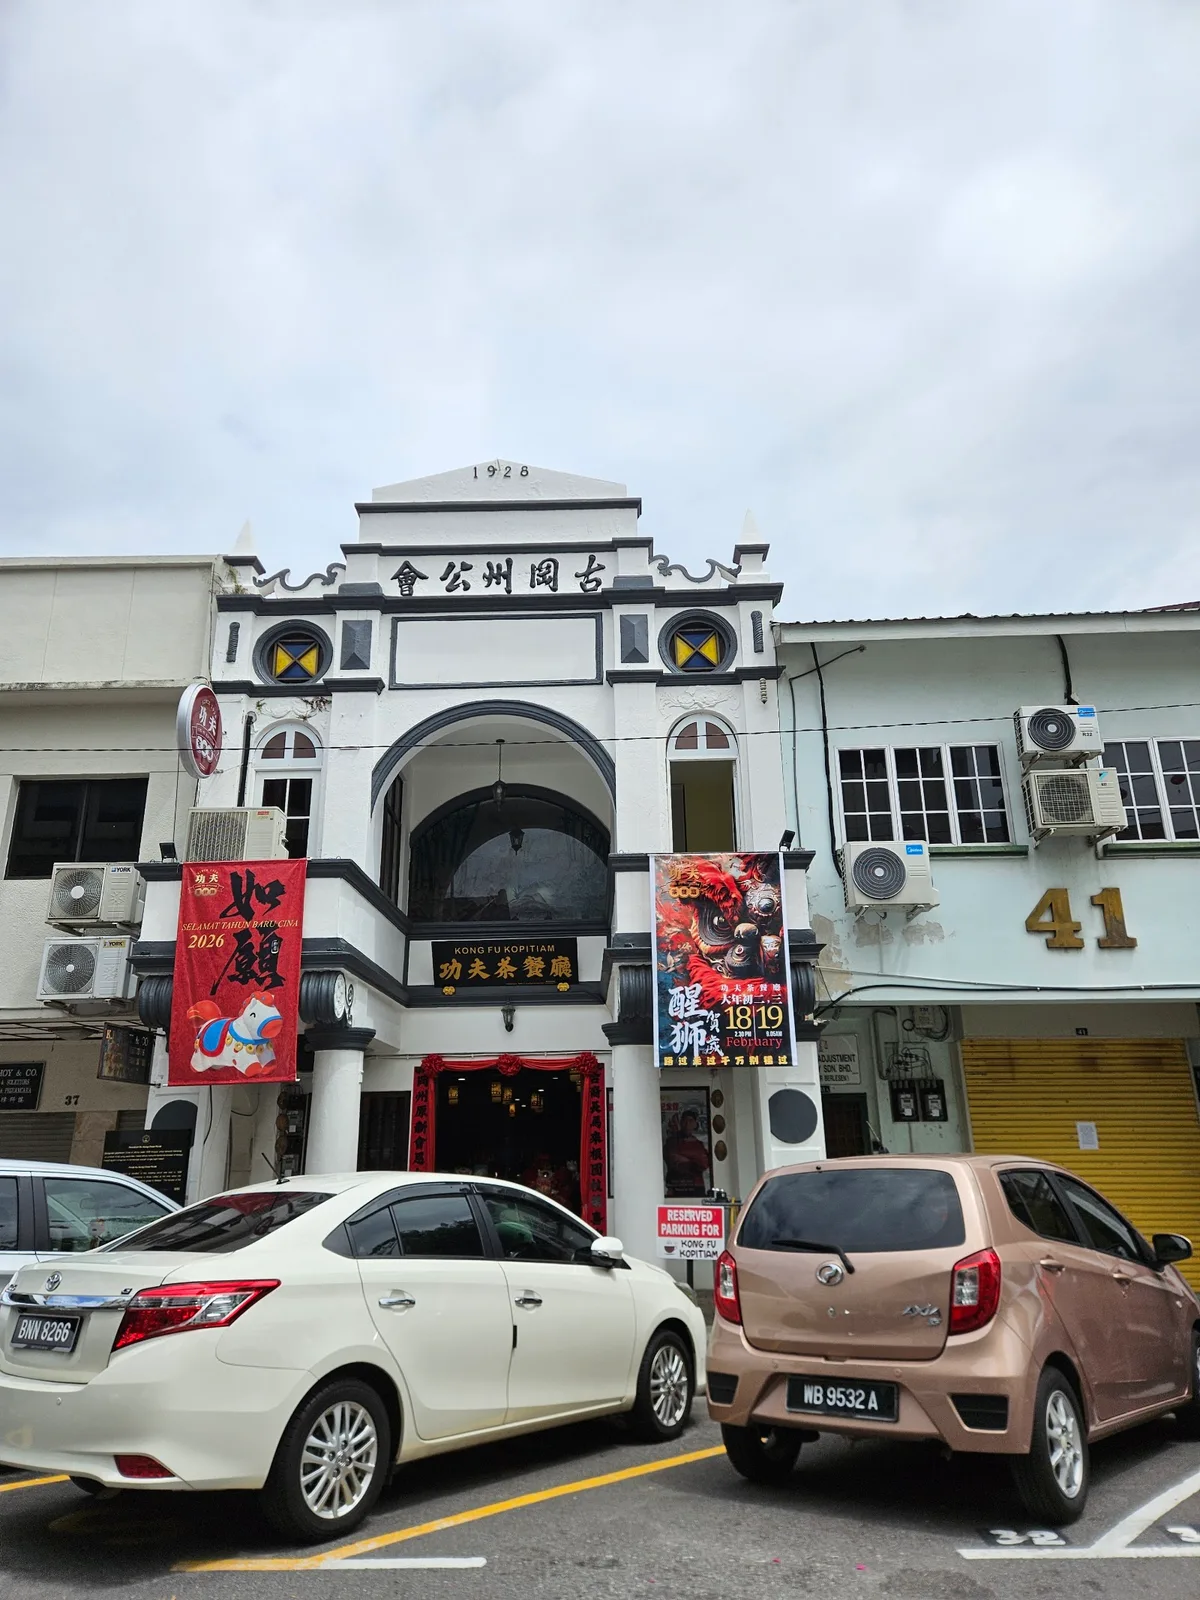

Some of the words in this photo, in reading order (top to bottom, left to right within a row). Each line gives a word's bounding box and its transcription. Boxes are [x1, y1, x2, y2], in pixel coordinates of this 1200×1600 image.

[472, 465, 529, 479] 1928
[1025, 887, 1138, 949] 41
[182, 922, 219, 931] SELAMAT
[221, 921, 251, 930] TAHUN
[252, 920, 276, 929] BARU
[278, 919, 299, 928] CINA
[188, 934, 226, 949] 2026
[454, 946, 485, 955] KONG
[488, 946, 501, 954] FU
[504, 944, 556, 953] KOPITIAM
[439, 956, 573, 980] 功夫茶餐廳
[724, 1005, 752, 1030] 18
[756, 1005, 783, 1030] 19
[726, 1037, 783, 1049] February
[65, 1095, 80, 1106] 37
[667, 1209, 713, 1222] RESERVED
[661, 1223, 700, 1236] PARKING
[701, 1224, 720, 1236] FOR
[681, 1240, 704, 1248] KONG
[707, 1240, 716, 1248] FU
[680, 1250, 718, 1258] KOPITIAM
[19, 1320, 42, 1340] BNN
[41, 1322, 71, 1342] 8266
[803, 1384, 824, 1405] WB
[990, 1529, 1067, 1546] 32
